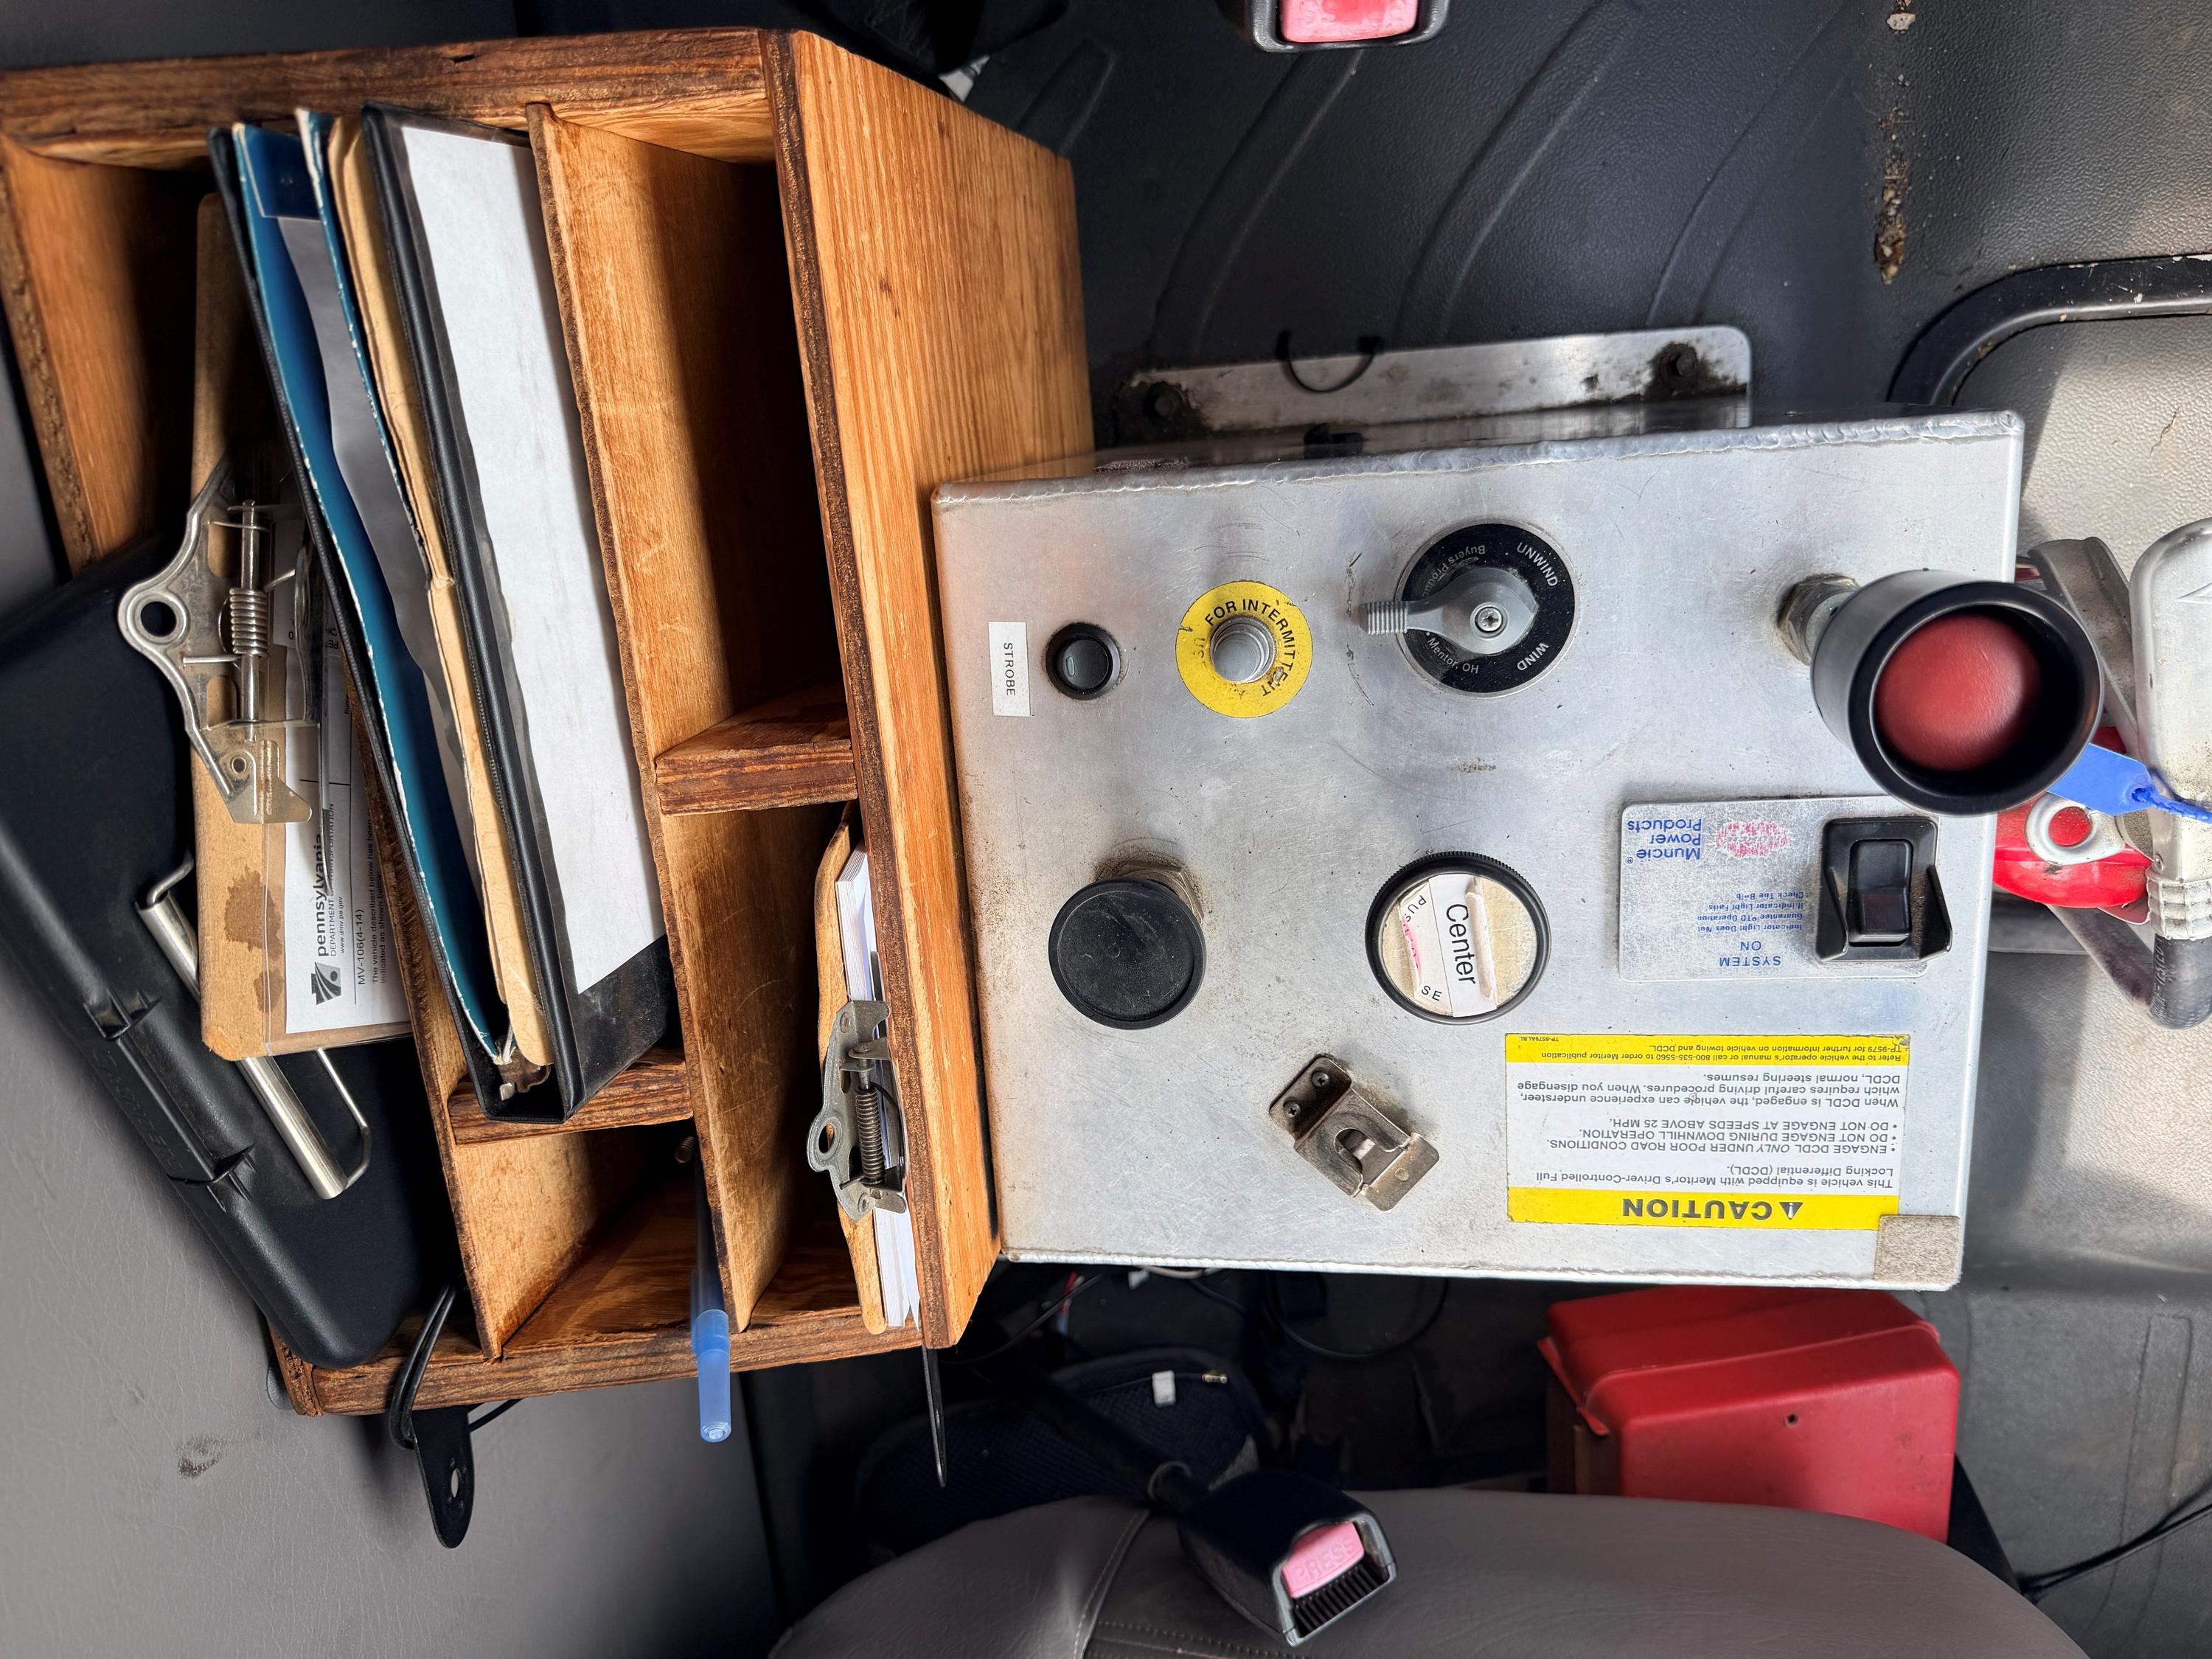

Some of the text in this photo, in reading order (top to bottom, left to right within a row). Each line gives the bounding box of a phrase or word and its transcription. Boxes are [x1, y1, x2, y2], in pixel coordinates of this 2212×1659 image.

[1447, 544, 1486, 564] Buyers
[1516, 542, 1559, 587] UNWIND
[1204, 600, 1237, 627] FOR
[1427, 636, 1479, 674] Mentor, OH
[1516, 642, 1551, 672] WIND
[1004, 642, 1016, 696] STROBE
[1627, 818, 1702, 833] Products
[1649, 833, 1701, 846] Power
[367, 861, 375, 888] below
[314, 834, 330, 958] pennsylvania
[1777, 891, 1804, 900] Check
[368, 889, 377, 933] described
[1697, 914, 1738, 922] Operation
[328, 899, 337, 957] DEPARTMENT
[1715, 925, 1737, 933] Does
[1739, 923, 1761, 932] Light
[379, 931, 386, 943] as
[355, 908, 366, 986] MV-106(4-14)
[1445, 903, 1476, 984] Center
[1740, 940, 1761, 951] ON
[1719, 956, 1781, 967] SYSTEM
[1696, 1044, 1724, 1052] towing
[1763, 1073, 1812, 1083] steering
[1816, 1075, 1858, 1083] normal
[1862, 1074, 1899, 1084] DCDL,
[1517, 1081, 1899, 1096] which requires careful driving procedures. When you disengage
[1520, 1092, 1585, 1103] understeer,
[1590, 1094, 1655, 1105] experience
[1684, 1096, 1725, 1106] vehicle
[1730, 1098, 1749, 1107] the
[1752, 1096, 1807, 1107] engaged,
[1811, 1099, 1821, 1107] is
[1825, 1099, 1860, 1107] DCDL
[1865, 1099, 1899, 1107] When
[1610, 1119, 1888, 1130] DO NOT ENGAGE AT SPEEDS ABOVE 25 MPH.
[1579, 1130, 1888, 1142] DO NOT ENGAGE DURING DOWNHILL OPERATION.
[1547, 1140, 1887, 1154] ENGAGE DCDL ONLY UNDER POOR ROAD CONDITIONS.
[1727, 1164, 1893, 1177] Locking Differential (DCDL).
[1536, 1172, 1893, 1188] This vehicle is equipped with Meritor's Driver-Controlled Full
[1623, 1199, 1772, 1220] CAUTION
[1290, 1534, 1357, 1584] PRESS
